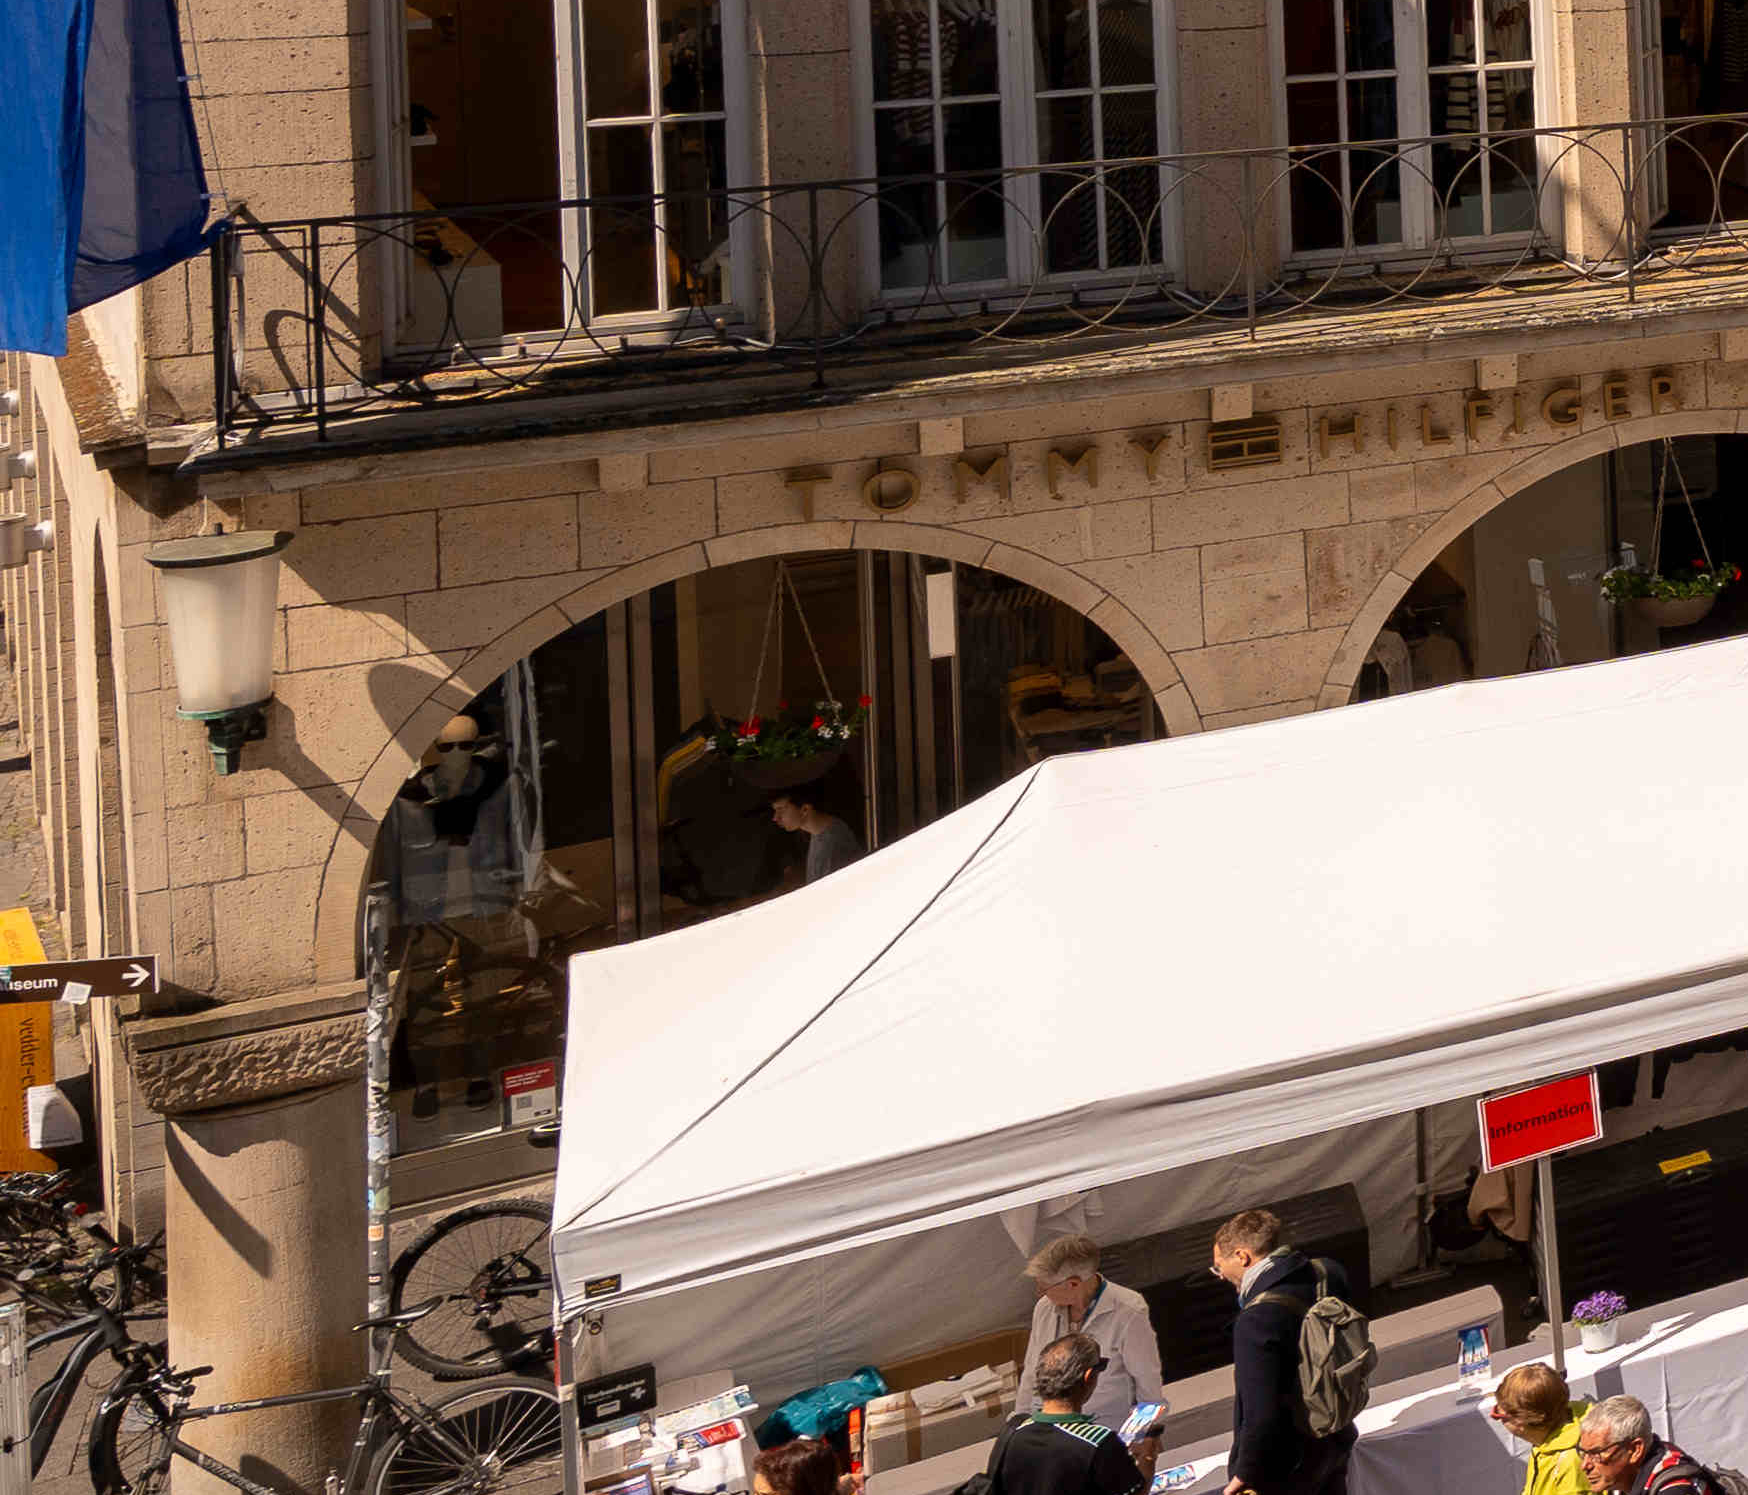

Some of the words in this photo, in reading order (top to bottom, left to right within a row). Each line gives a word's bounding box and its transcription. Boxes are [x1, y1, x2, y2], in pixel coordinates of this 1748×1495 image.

[783, 432, 1172, 523] TOMMY
[1319, 373, 1683, 459] HILFIGER
[1490, 1101, 1591, 1139] Information
